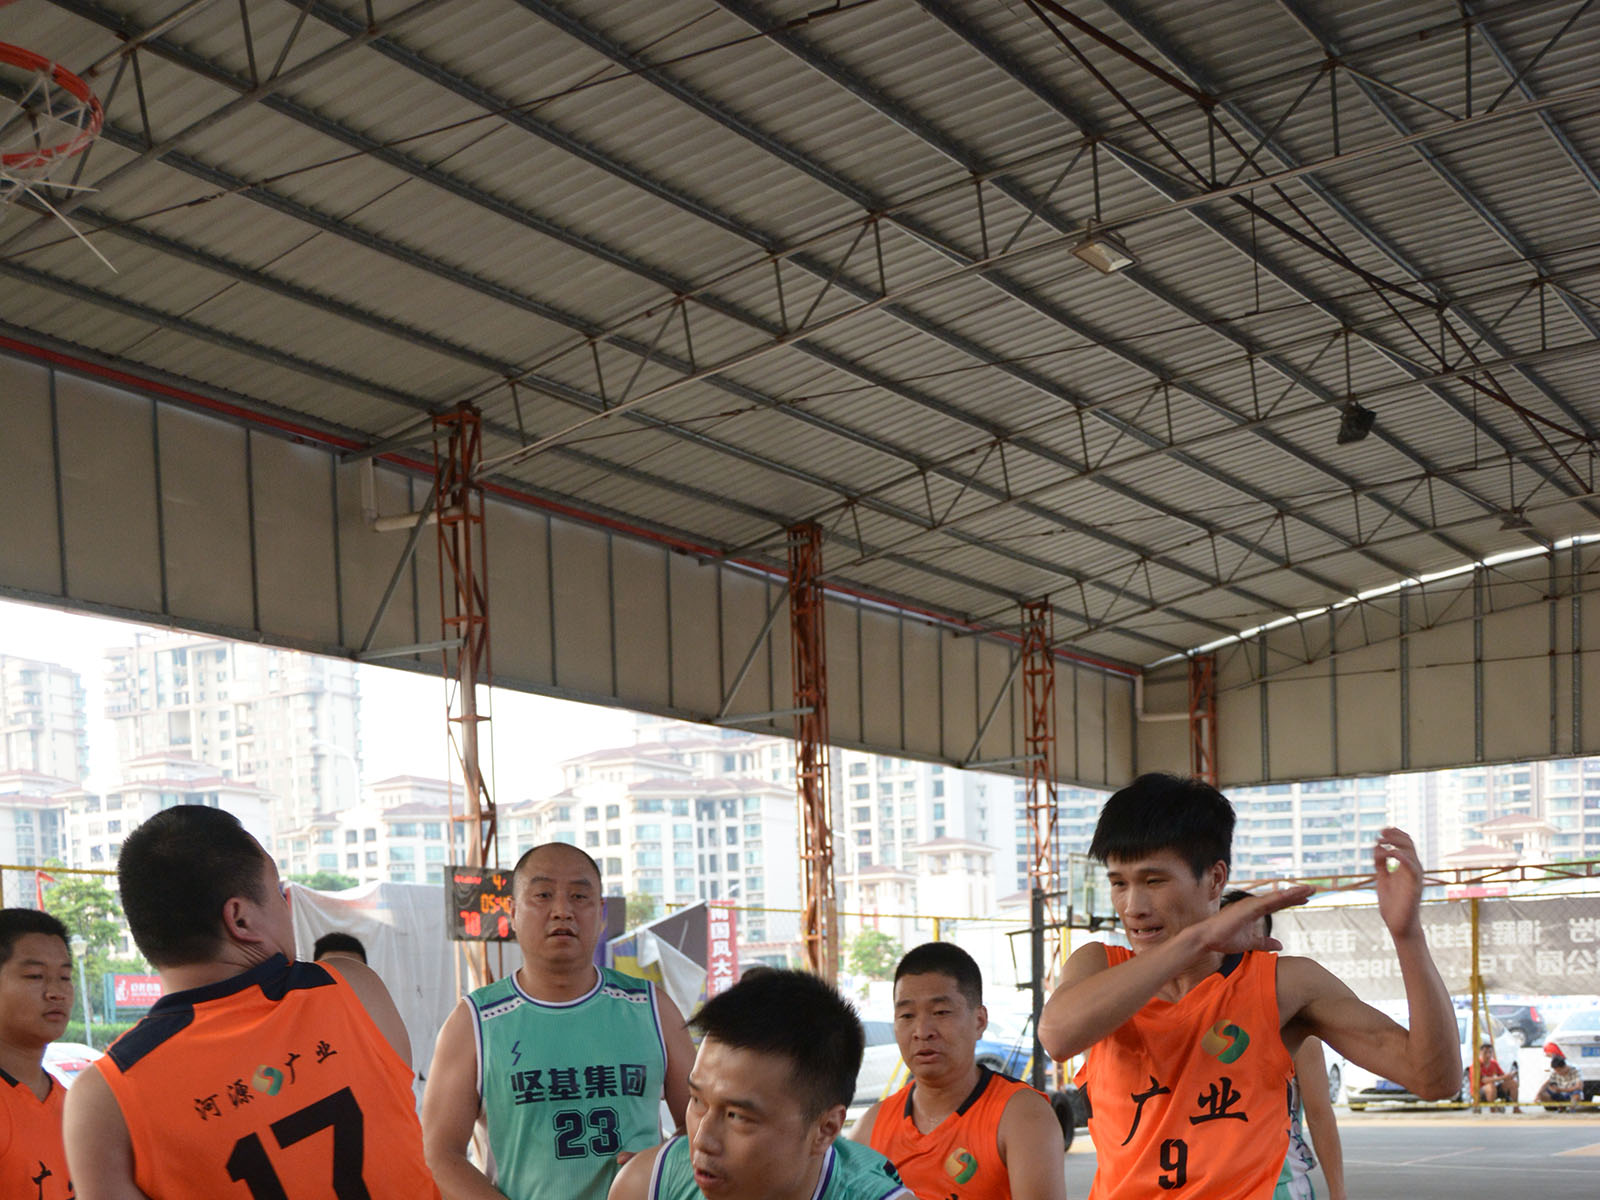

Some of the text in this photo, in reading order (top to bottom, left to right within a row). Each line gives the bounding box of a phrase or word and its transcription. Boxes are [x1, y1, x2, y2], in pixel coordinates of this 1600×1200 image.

[511, 1063, 647, 1105] 坚基集团
[552, 1106, 622, 1161] 23
[1158, 1139, 1188, 1190] 9
